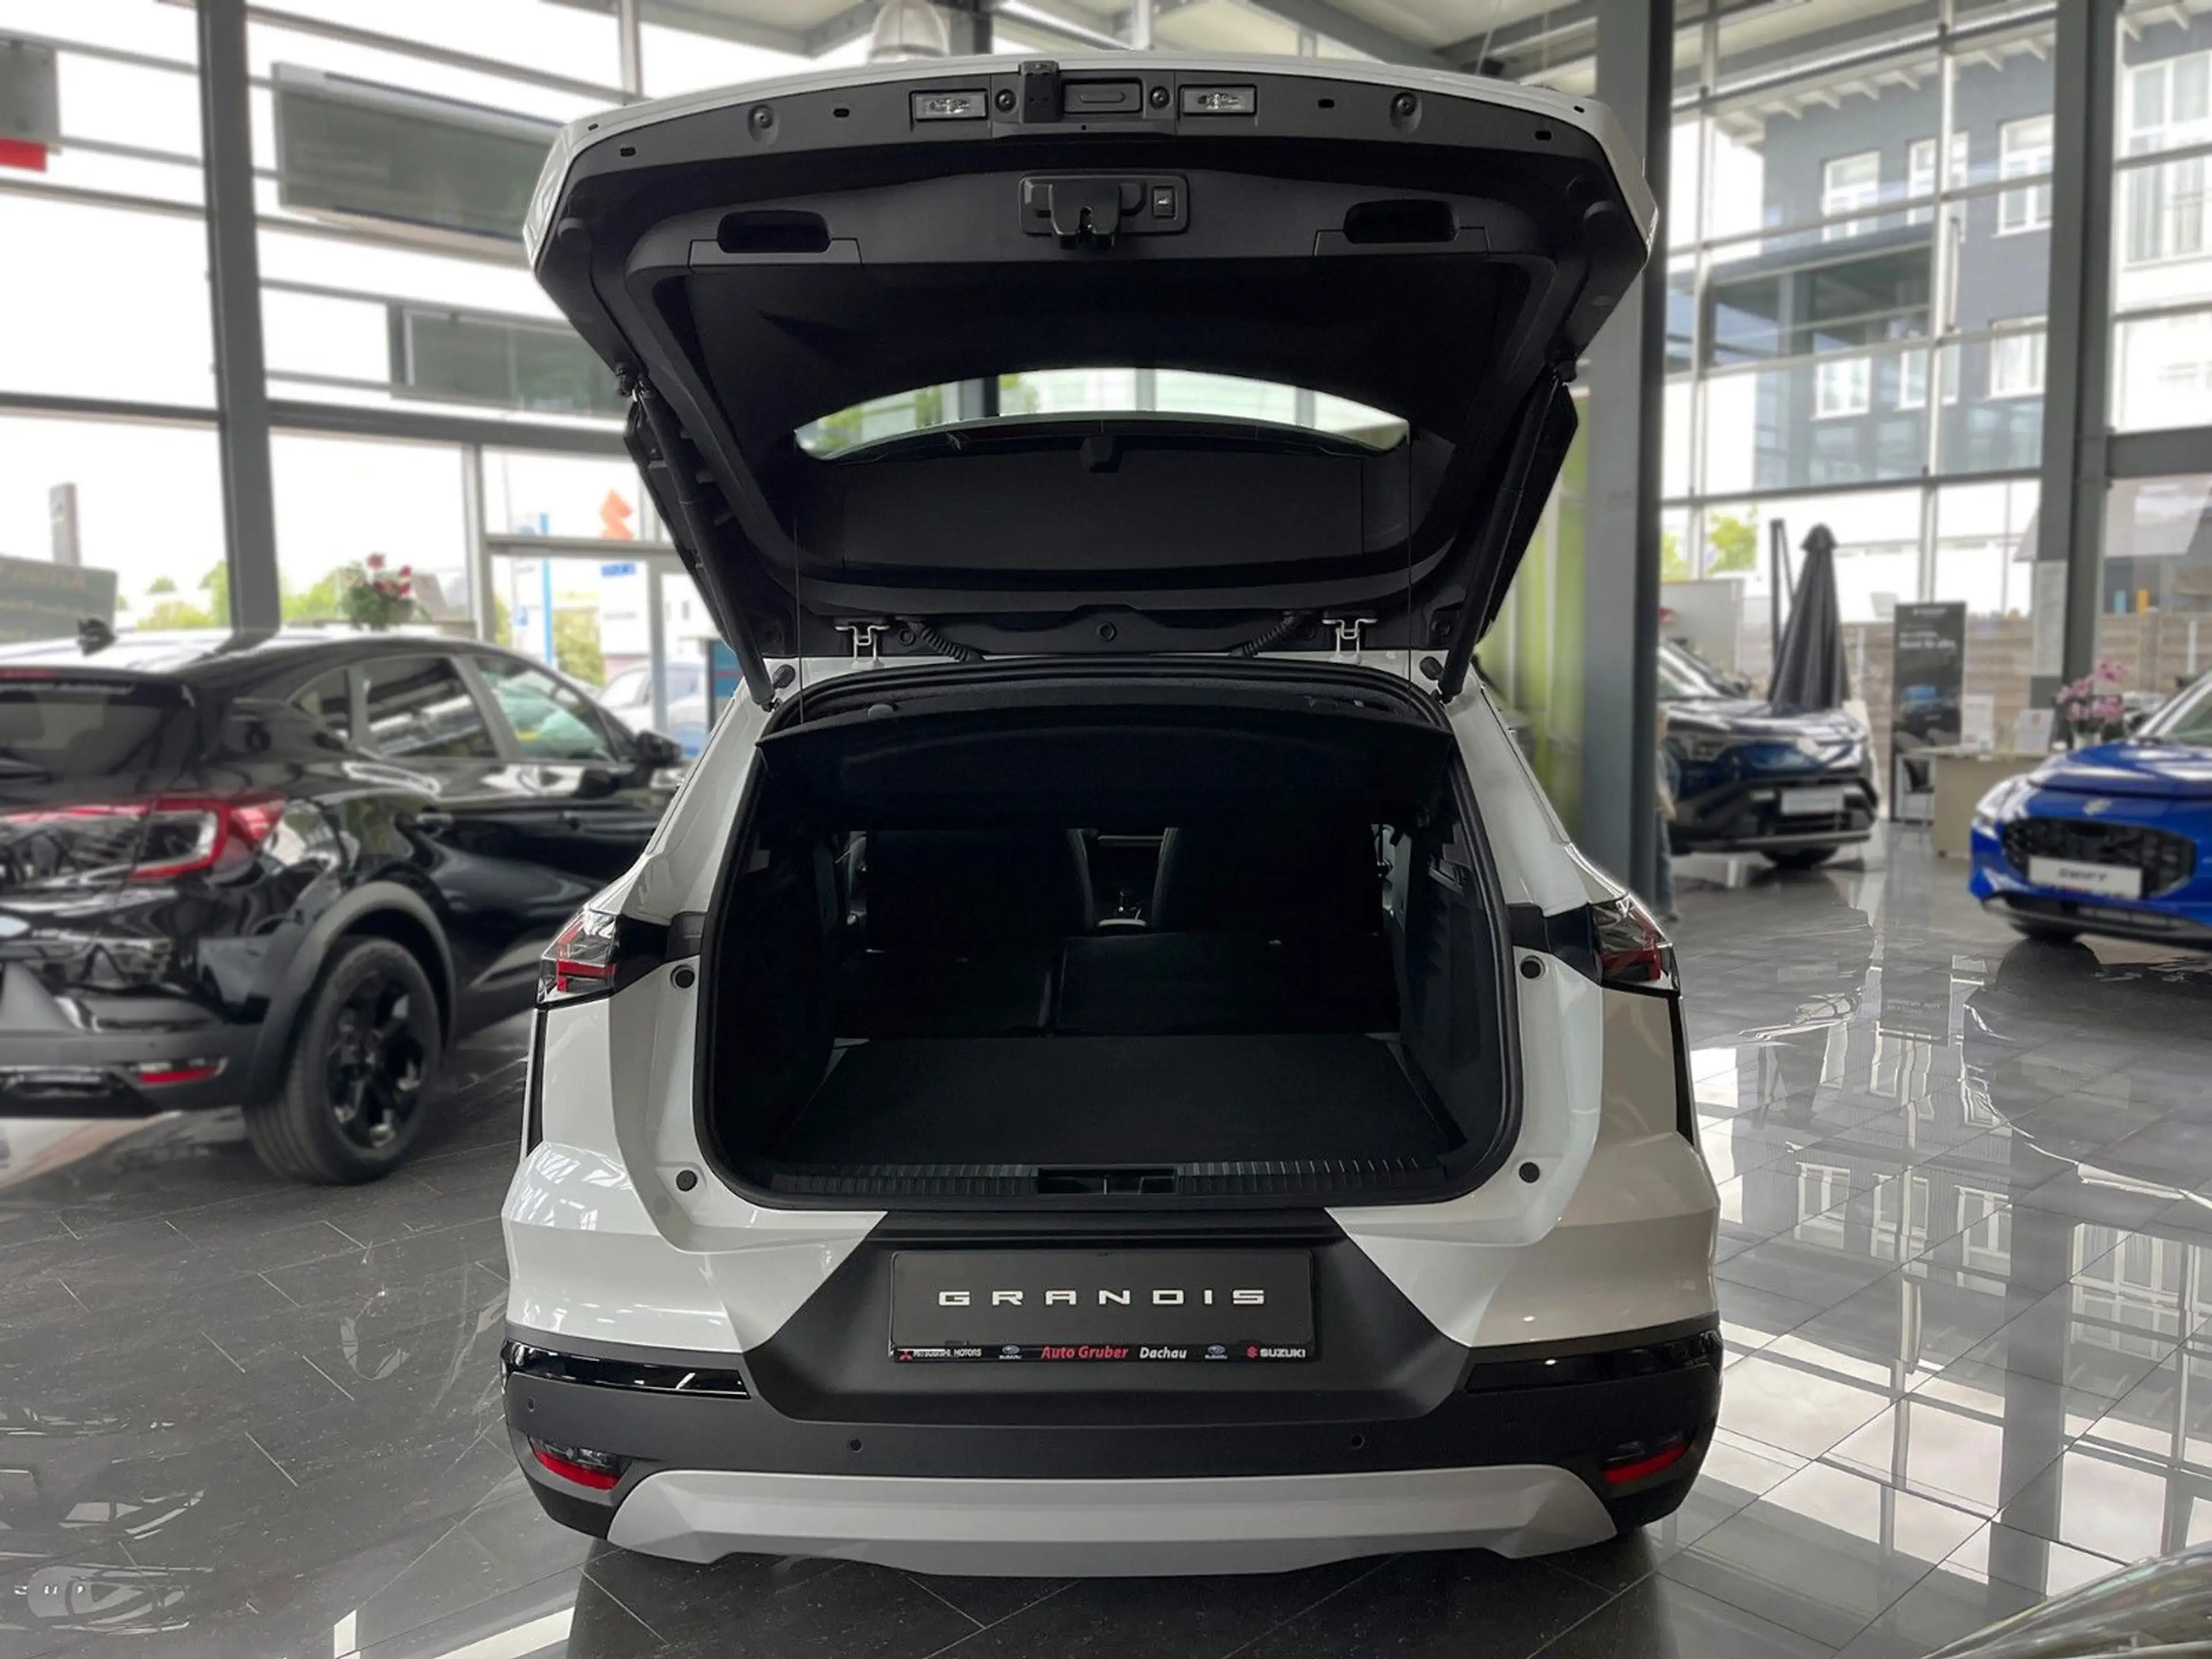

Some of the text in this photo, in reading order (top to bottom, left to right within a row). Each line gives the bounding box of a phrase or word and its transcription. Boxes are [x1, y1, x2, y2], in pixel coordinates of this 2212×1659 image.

[938, 1290, 1264, 1305] GRANDIS
[1041, 1345, 1187, 1359] Auto Gruber Dachau
[1259, 1348, 1306, 1358] SUZUKI
